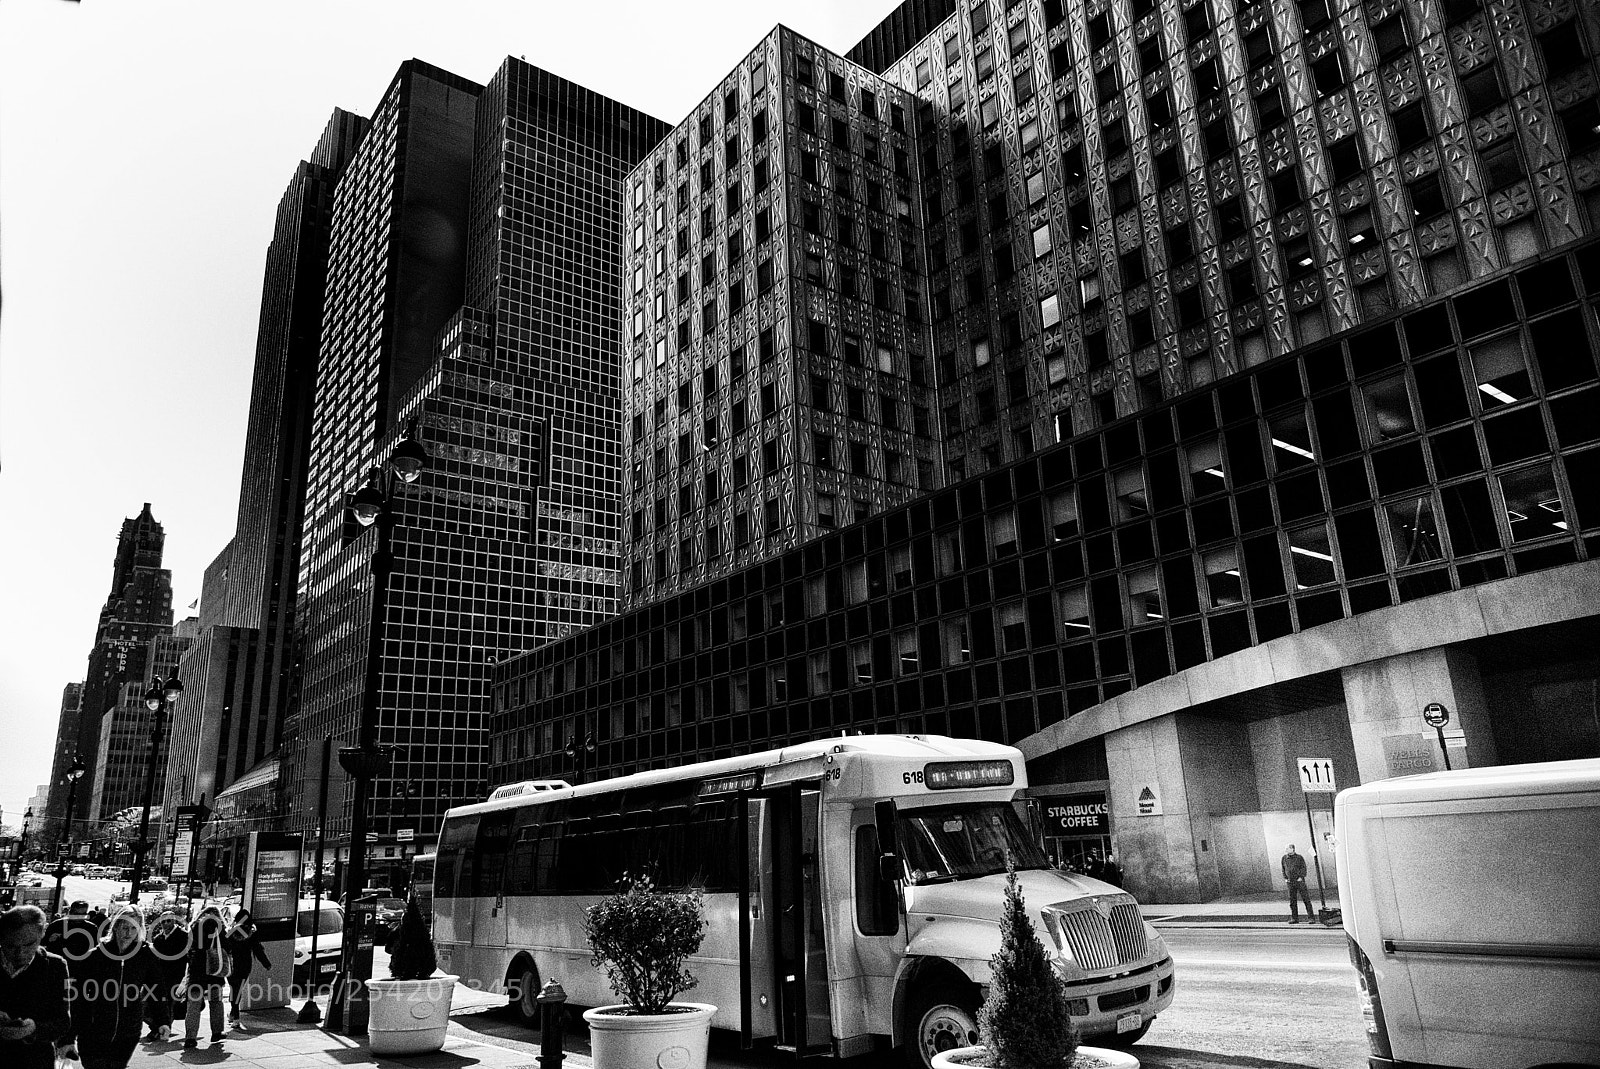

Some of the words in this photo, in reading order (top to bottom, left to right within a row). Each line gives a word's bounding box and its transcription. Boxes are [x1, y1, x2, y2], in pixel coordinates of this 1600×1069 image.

[1392, 749, 1430, 759] WELLS
[1392, 759, 1432, 769] FARGO
[825, 768, 841, 781] 618
[902, 771, 924, 784] 618
[1047, 803, 1109, 818] STARBUCKS
[1060, 815, 1100, 828] COFFEE
[364, 913, 373, 925] P
